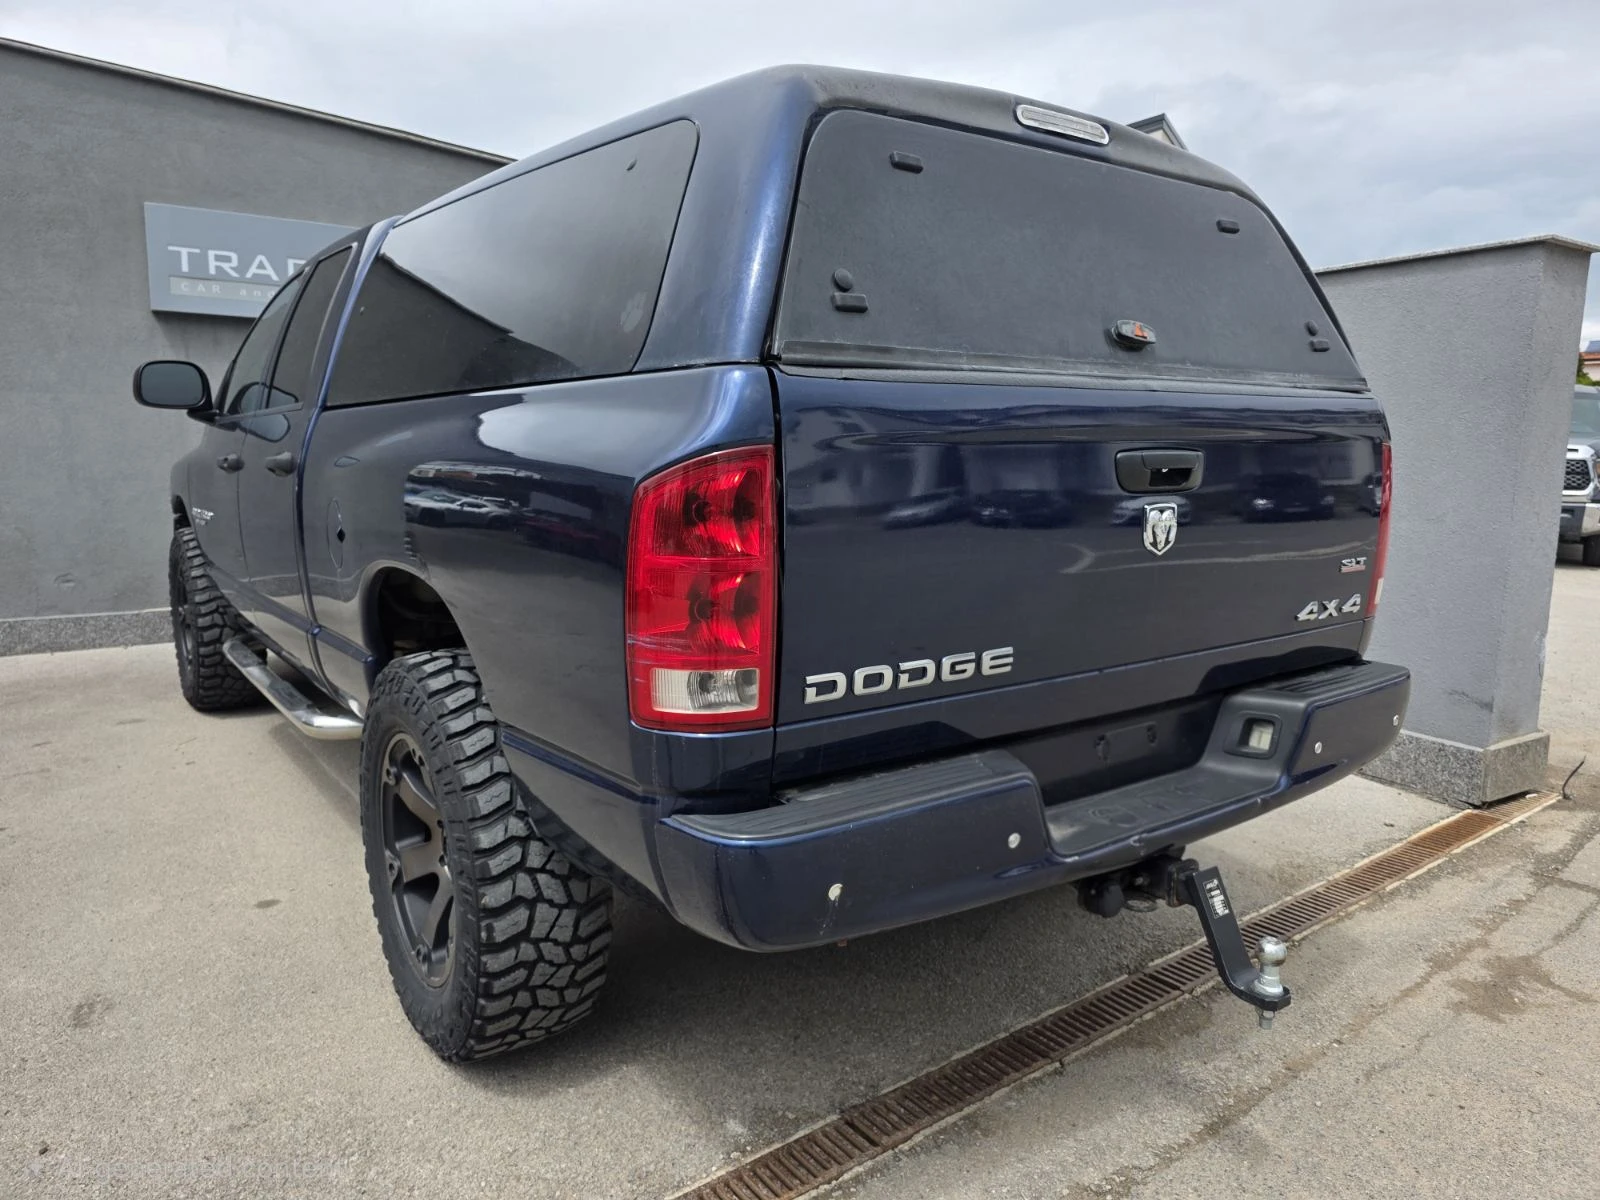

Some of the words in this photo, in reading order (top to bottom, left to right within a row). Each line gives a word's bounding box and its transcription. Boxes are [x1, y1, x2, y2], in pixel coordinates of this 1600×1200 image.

[180, 281, 221, 294] CAR
[1341, 557, 1367, 567] SLT
[1295, 594, 1361, 621] 4X4
[804, 646, 1014, 704] DODGE
